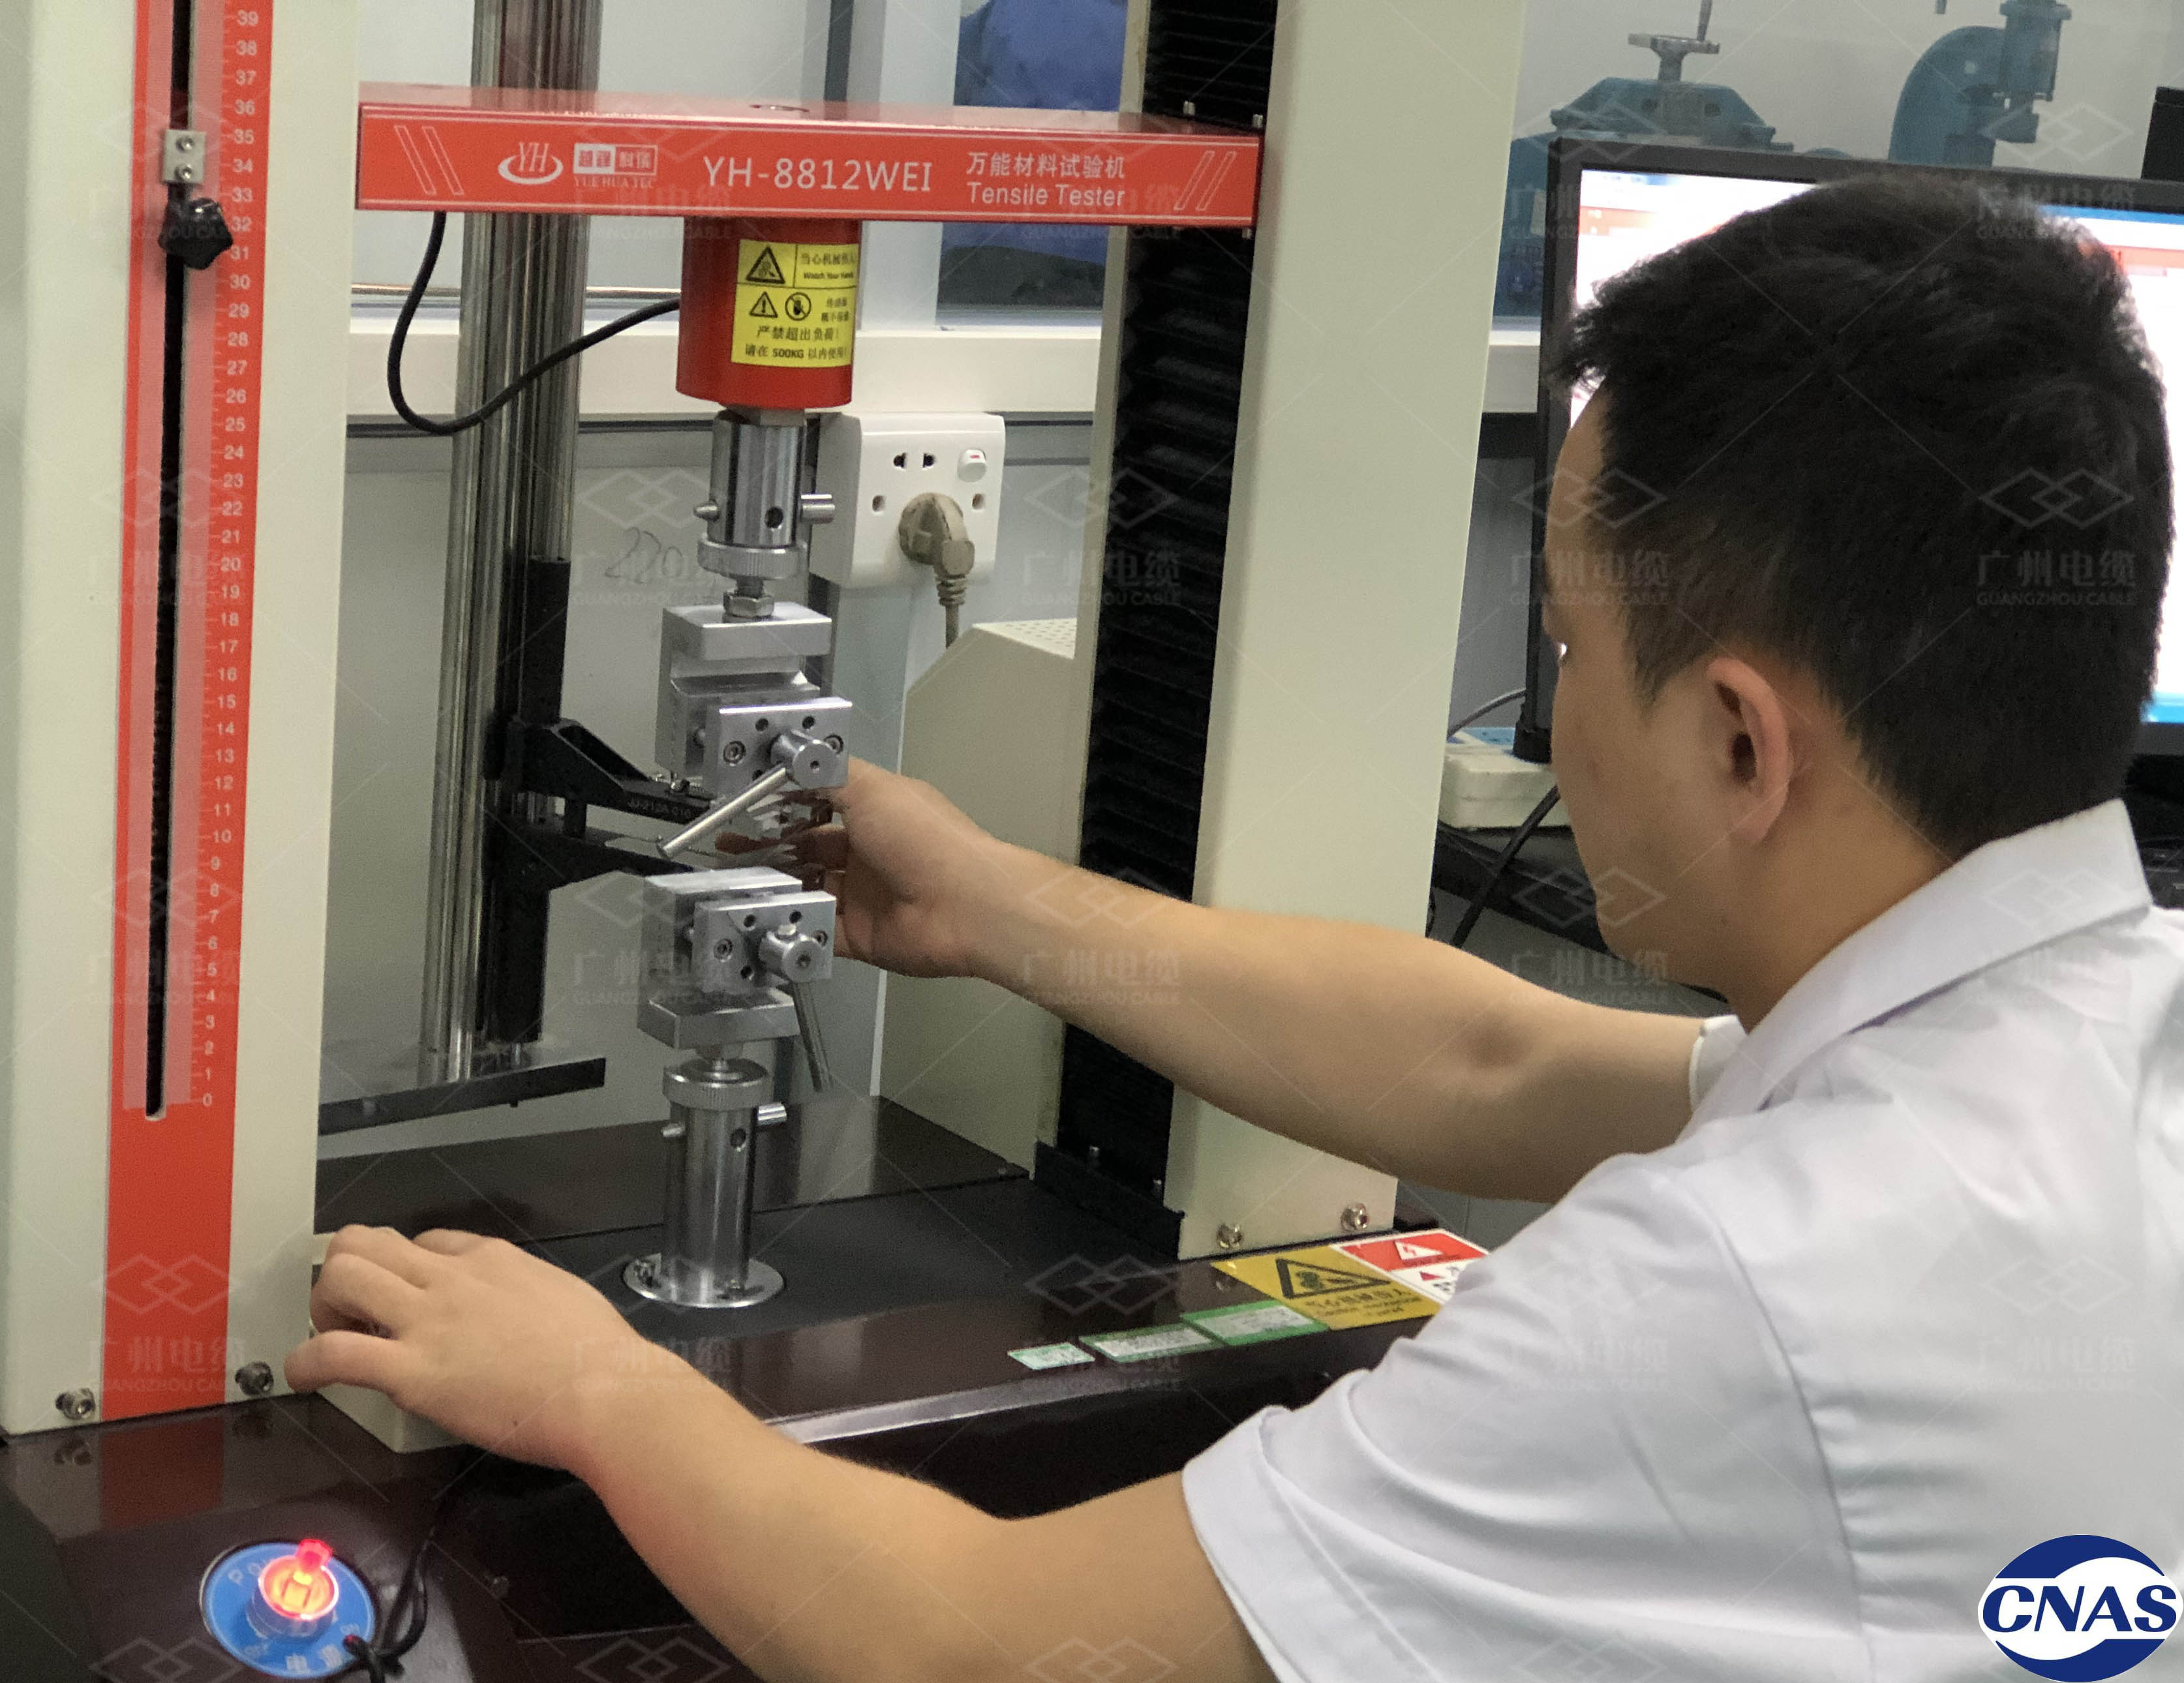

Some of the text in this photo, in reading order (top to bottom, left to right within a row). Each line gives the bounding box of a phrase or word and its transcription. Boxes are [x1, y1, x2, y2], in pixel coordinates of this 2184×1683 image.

[237, 10, 258, 26] 39
[237, 40, 257, 56] 38
[236, 70, 256, 85] 37
[235, 99, 255, 115] 36
[234, 129, 254, 144] 35
[519, 142, 549, 172] YH
[234, 159, 253, 173] 34
[966, 152, 1125, 179] 万能材料试验机
[703, 156, 932, 192] YH-8812WEI
[232, 187, 252, 202] 33
[967, 181, 1125, 207] Tensile Tester
[231, 215, 252, 232] 32
[230, 245, 249, 260] 31
[231, 274, 250, 290] 30
[229, 303, 250, 318] 29
[228, 332, 249, 346] 28
[772, 348, 804, 358] 500KG
[227, 360, 247, 375] 27
[226, 389, 246, 404] 26
[225, 417, 245, 432] 25
[224, 445, 244, 459] 24
[222, 473, 243, 489] 23
[222, 500, 243, 516] 22
[222, 530, 239, 543] 21
[221, 556, 241, 572] 20
[222, 584, 239, 599] 19
[221, 613, 239, 626] 18
[220, 639, 238, 653] 17
[219, 667, 237, 682] 16
[218, 694, 236, 708] 15
[218, 722, 234, 735] 14
[216, 748, 235, 763] 13
[215, 775, 234, 790] 12
[215, 803, 230, 816] 11
[214, 829, 232, 843] 10
[211, 856, 220, 870] 9
[209, 882, 220, 897] 8
[209, 909, 220, 923] 7
[207, 936, 217, 950] 6
[207, 962, 217, 977] 5
[207, 990, 215, 1001] 4
[205, 1015, 215, 1029] 3
[205, 1040, 214, 1055] 2
[205, 1067, 211, 1080] 1
[202, 1093, 213, 1106] 0
